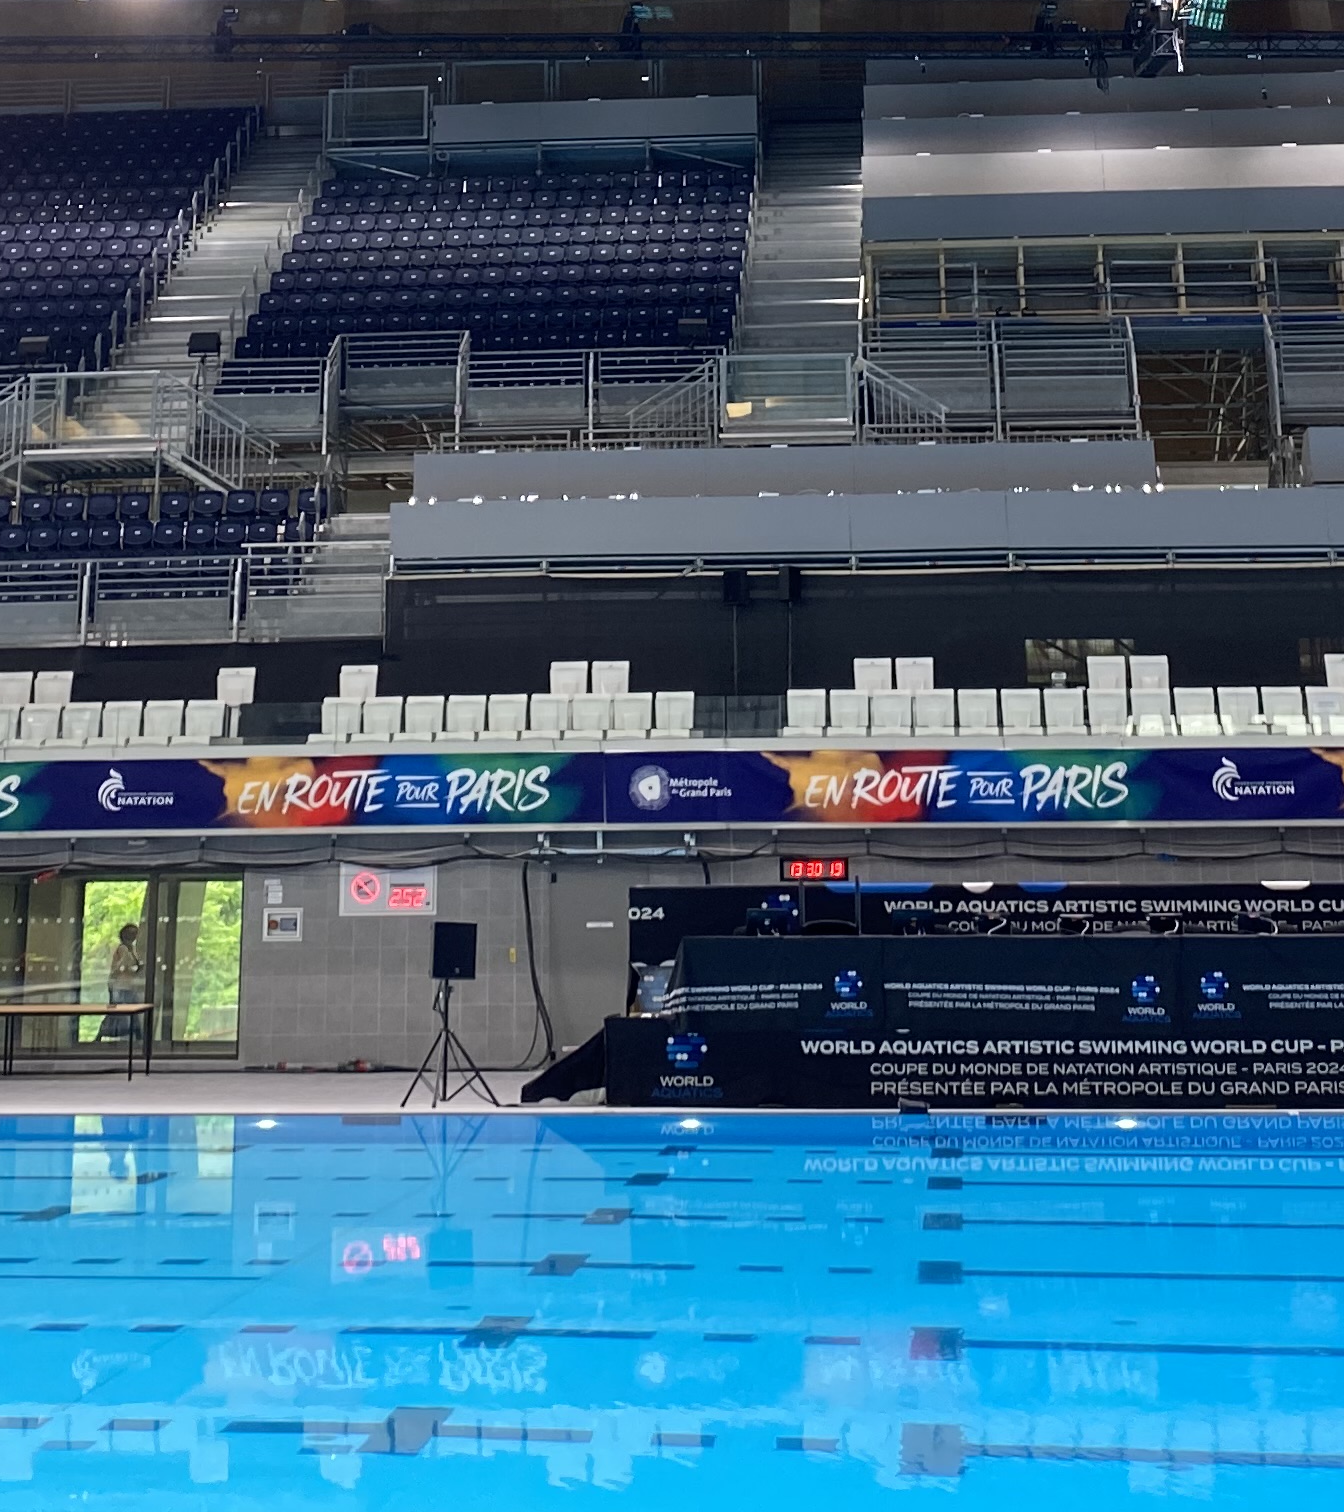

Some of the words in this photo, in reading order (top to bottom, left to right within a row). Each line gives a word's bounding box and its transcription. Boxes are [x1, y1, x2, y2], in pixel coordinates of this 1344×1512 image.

[669, 775, 719, 789] Métropole
[804, 774, 847, 809] EN
[852, 765, 962, 810] ROUTE
[970, 776, 1014, 800] POUR
[1020, 761, 1130, 812] PARIS
[238, 780, 274, 815] EN
[281, 769, 392, 815] ROUTE
[396, 779, 440, 803] POUR
[445, 765, 552, 815] PARIS
[679, 786, 708, 799] Grand
[709, 787, 733, 798] Paris
[1234, 783, 1296, 796] NATATION
[116, 794, 174, 807] NATATION
[956, 899, 1049, 914] AQUATICS
[1052, 899, 1137, 913] ARTISTIC
[1140, 899, 1242, 913] SWIMMING
[1244, 899, 1315, 912] WORLD
[831, 1001, 868, 1010] WORLD
[1127, 1006, 1165, 1016] WORLD
[1198, 1002, 1235, 1011] WORLD
[801, 1040, 875, 1054] WORLD
[879, 1040, 979, 1055] AQUATICS
[983, 1040, 1074, 1054] ARTISTIC
[1079, 1040, 1187, 1054] SWIMMING
[1191, 1040, 1266, 1054] WORLD
[1271, 1040, 1313, 1054] CUP
[870, 1063, 928, 1075] COUPE
[933, 1063, 956, 1075] DU
[961, 1063, 1022, 1075] MONDE
[1027, 1063, 1049, 1075] DE
[1054, 1063, 1134, 1075] NATATION
[1138, 1063, 1237, 1076] ARTISTIQUE
[1253, 1063, 1302, 1075] PARIS
[659, 1075, 714, 1087] WORLD
[871, 1078, 985, 1095] PRÉSENTÉE
[991, 1082, 1028, 1095] PAR
[1034, 1082, 1058, 1095] LA
[1063, 1078, 1183, 1095] MÉTROPOLE
[1188, 1082, 1215, 1095] DU
[1221, 1081, 1289, 1095] GRAND
